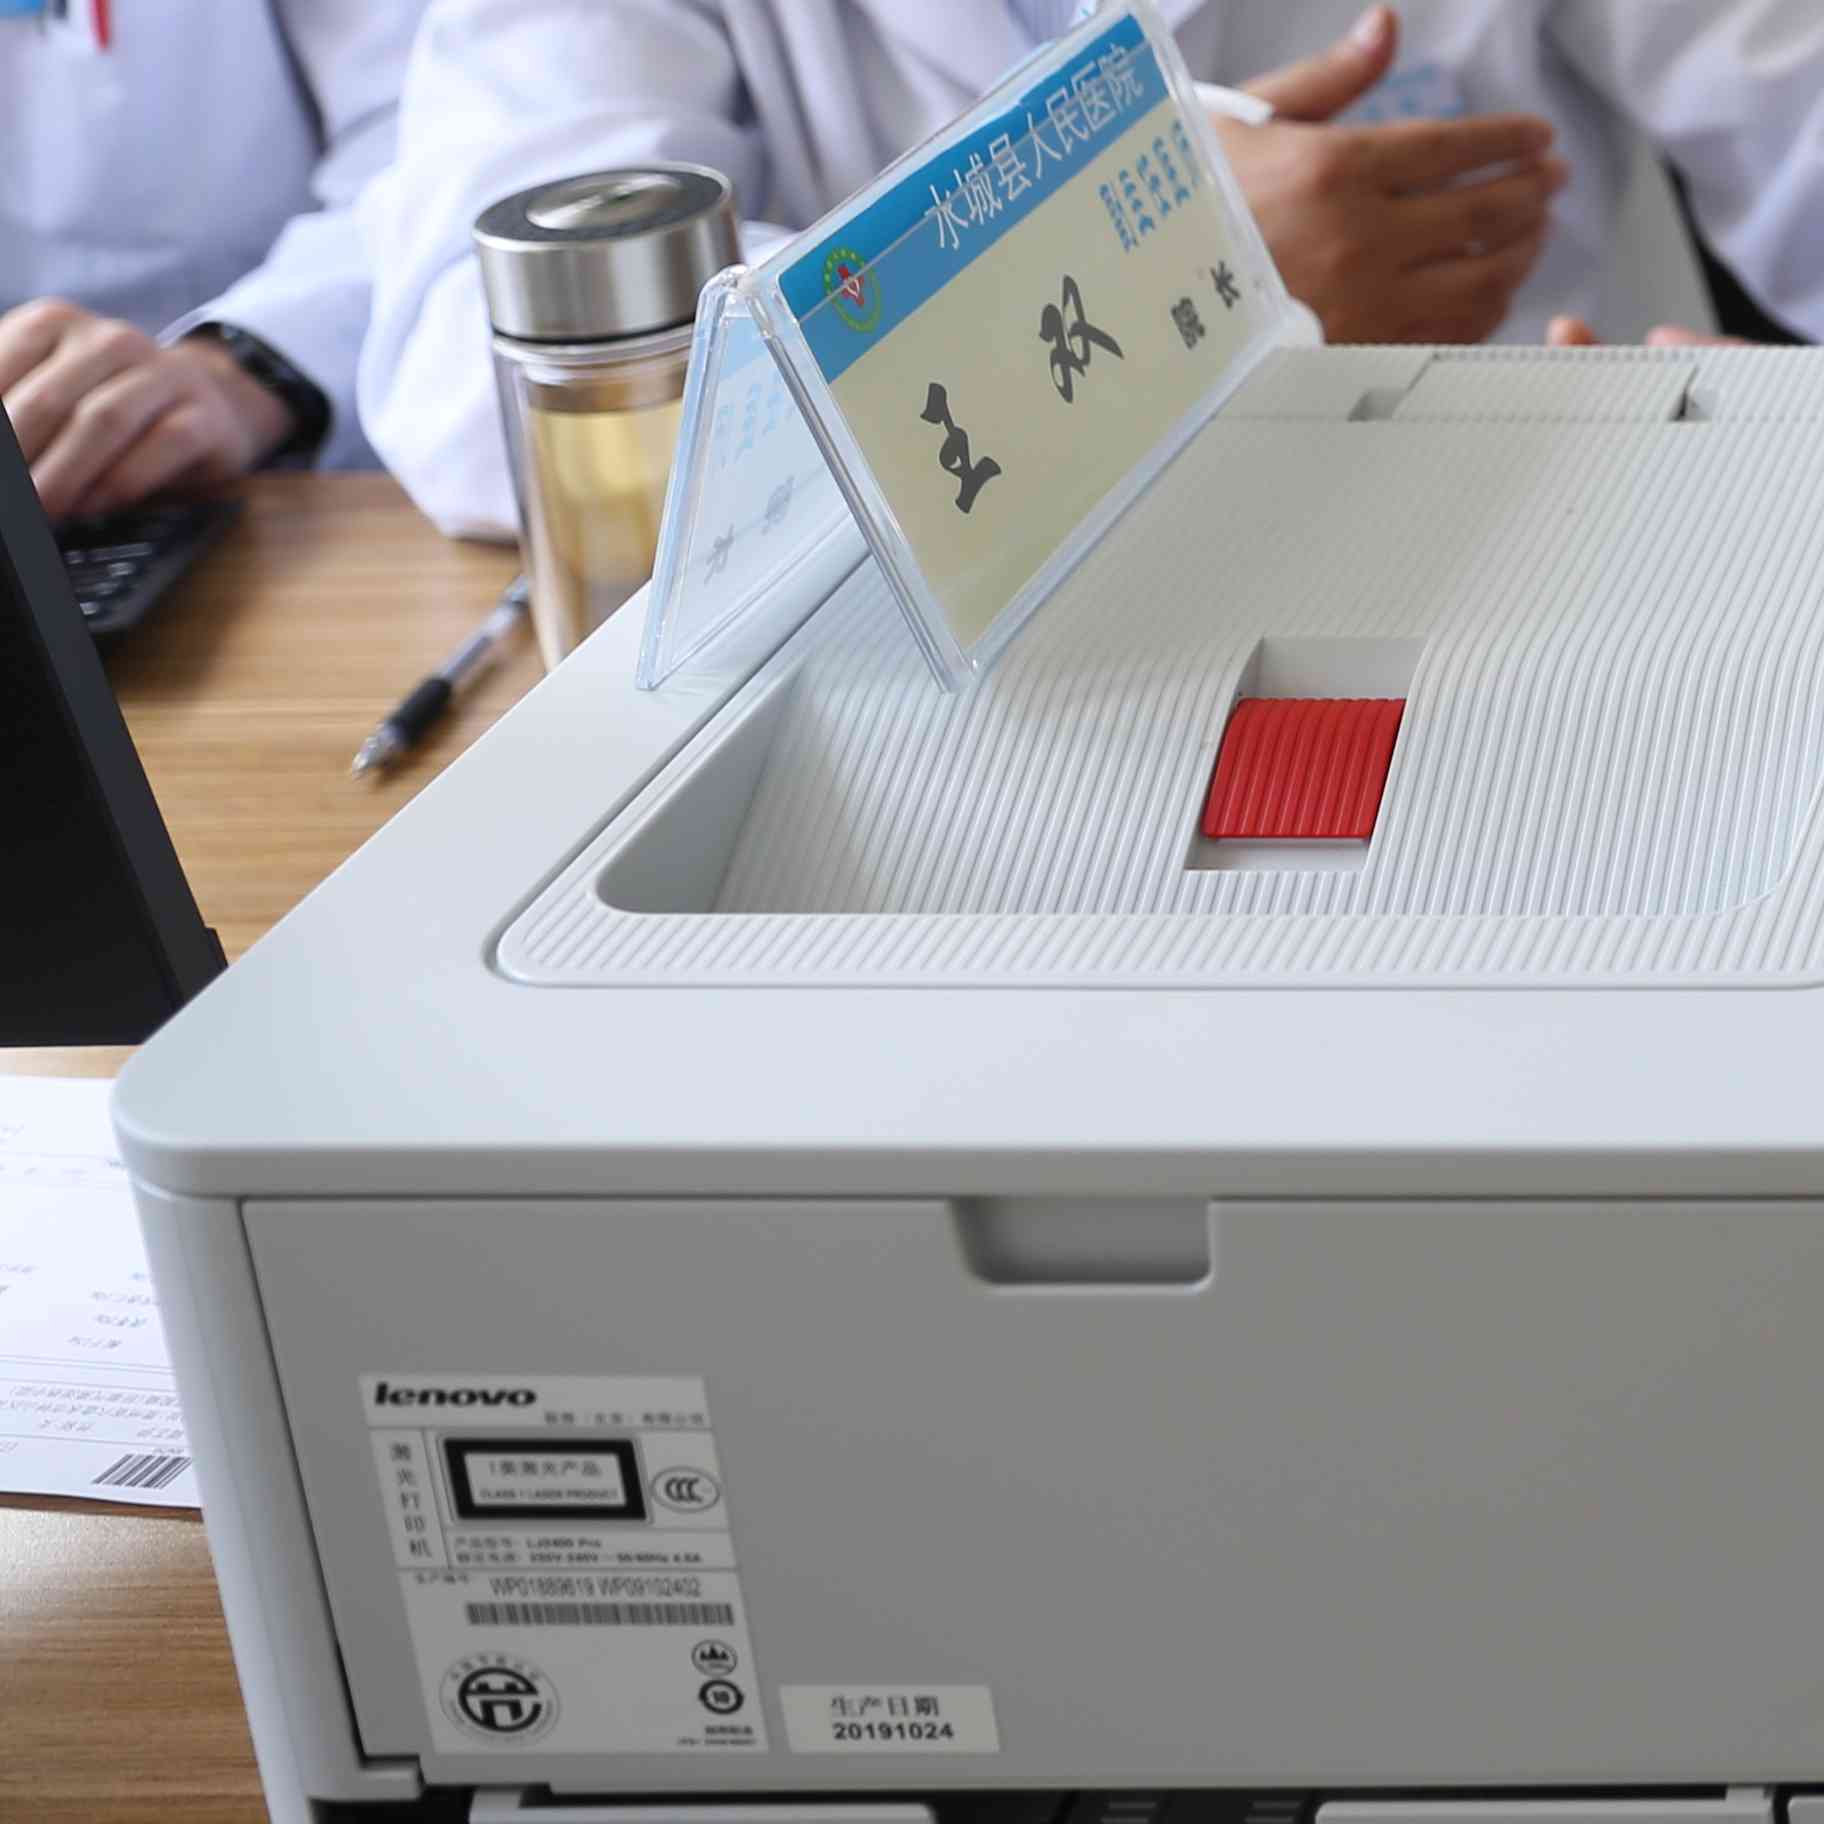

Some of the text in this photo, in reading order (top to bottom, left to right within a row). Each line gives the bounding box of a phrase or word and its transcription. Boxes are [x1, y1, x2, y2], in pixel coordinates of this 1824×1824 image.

[925, 43, 1145, 250] 水城县人民医院
[1170, 261, 1243, 348] 院长
[374, 1382, 537, 1407] lenovo
[832, 1695, 940, 1717] 生产日期
[833, 1723, 954, 1740] 20191024
